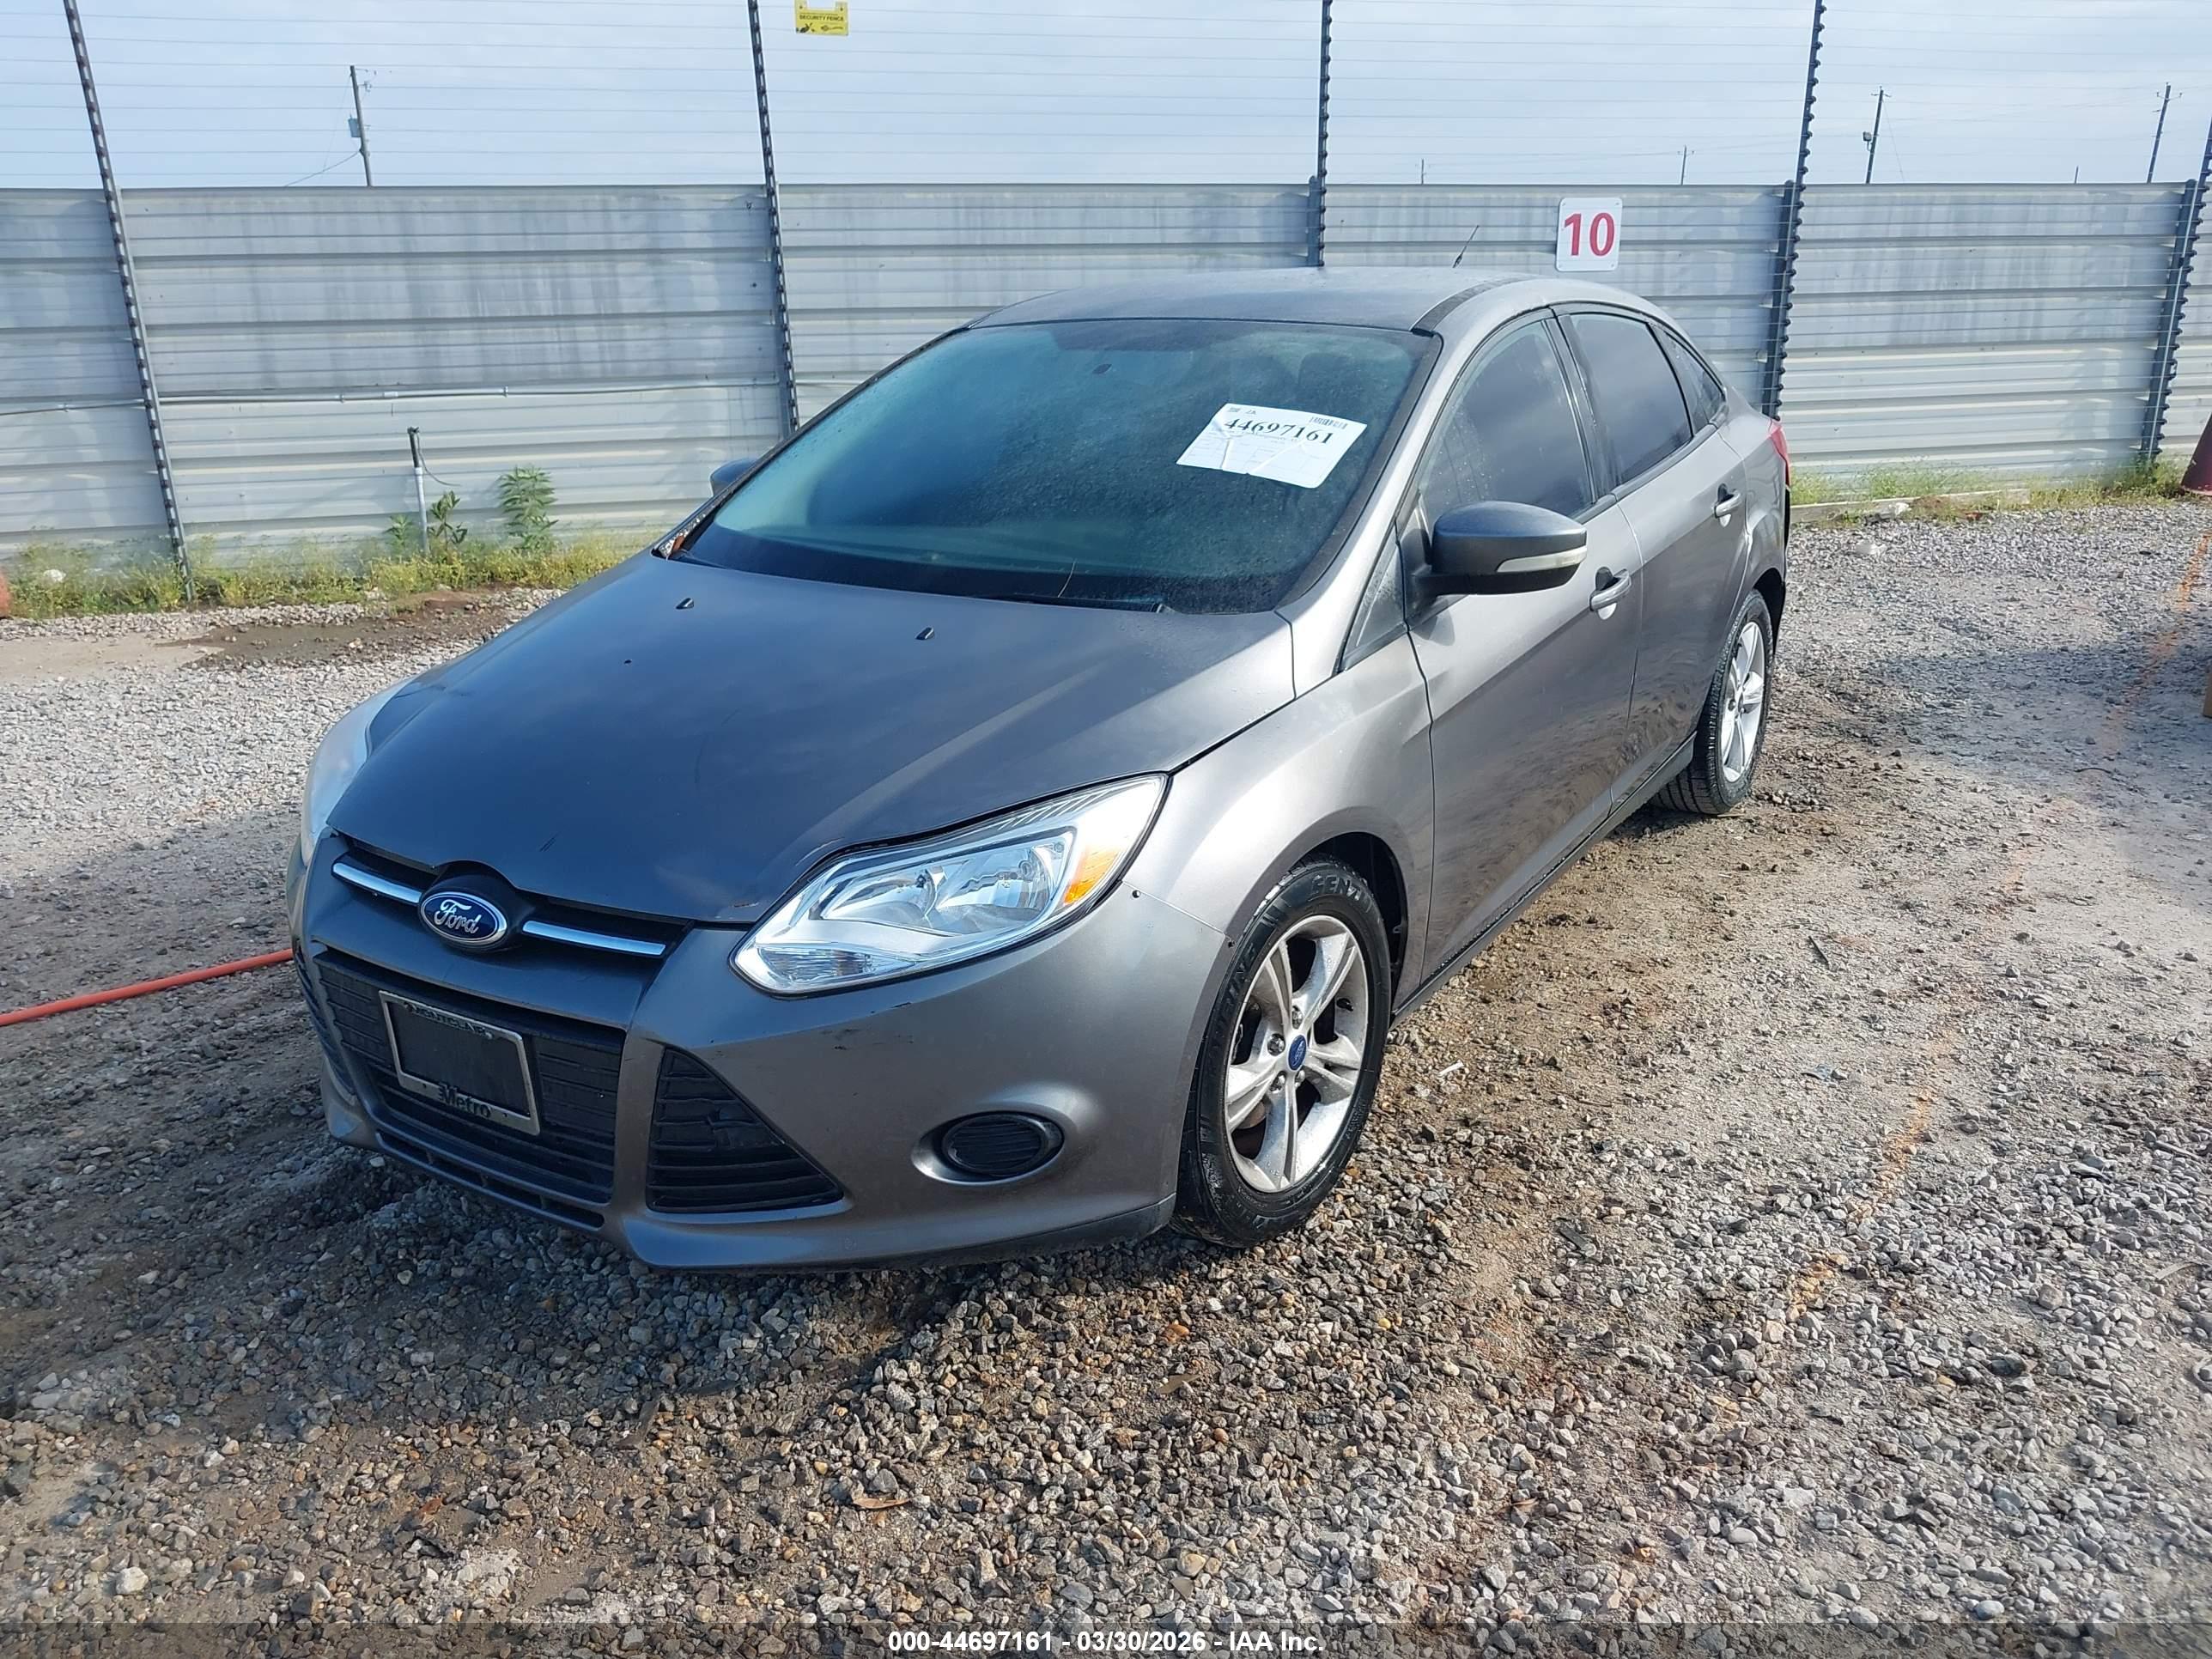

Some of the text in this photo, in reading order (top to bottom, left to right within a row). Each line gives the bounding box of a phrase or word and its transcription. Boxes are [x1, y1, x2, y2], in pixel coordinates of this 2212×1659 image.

[1564, 212, 1615, 257] 10
[1224, 417, 1334, 444] 44697161
[434, 899, 482, 934] Ford
[439, 1082, 492, 1119] Metro
